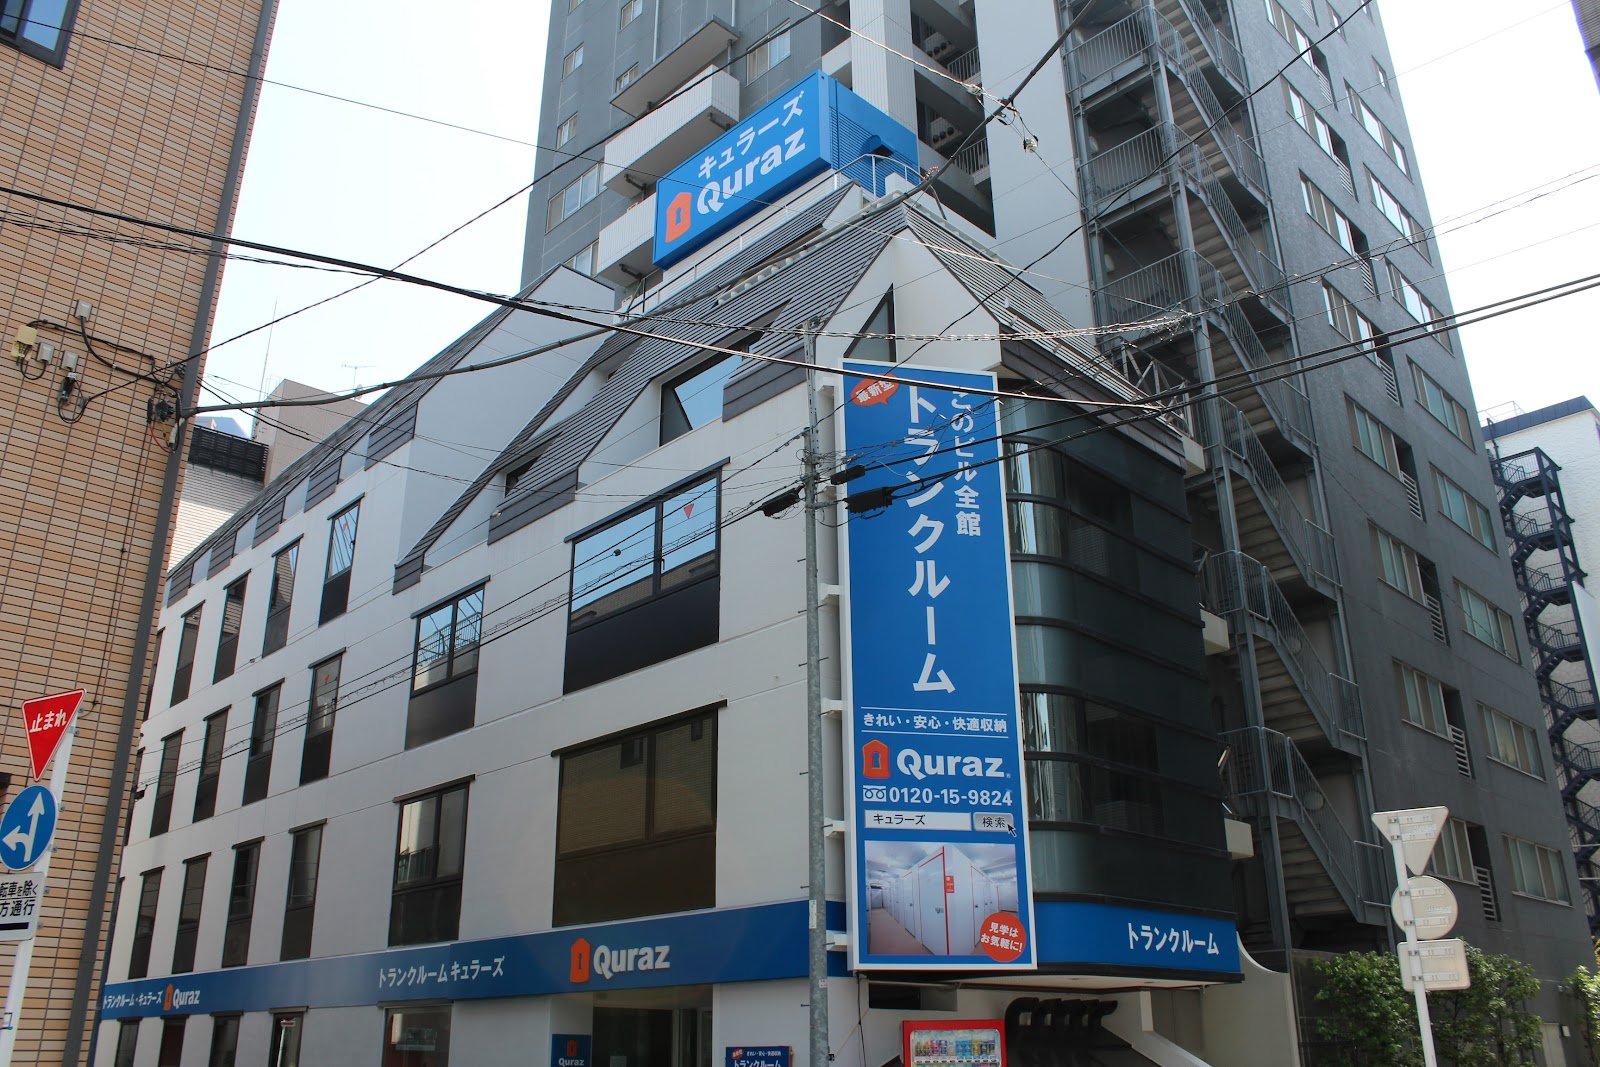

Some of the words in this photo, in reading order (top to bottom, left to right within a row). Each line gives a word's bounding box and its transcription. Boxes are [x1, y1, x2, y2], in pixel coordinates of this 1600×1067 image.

[698, 90, 805, 179] キュラーズ
[696, 127, 806, 215] Quraz
[856, 380, 895, 403] 最新型
[951, 391, 981, 537] このビル全館
[904, 385, 956, 694] トランクルーム
[29, 709, 67, 733] 止まれ
[863, 713, 1007, 733] きれい・安心・快適収納
[896, 748, 1005, 781] Quraz
[889, 787, 1013, 806] 0120-15-9824
[873, 813, 926, 825] キュラーズ
[982, 816, 1006, 828] 検索
[989, 921, 1019, 938] 見学は
[1127, 922, 1220, 955] トランクルーム
[593, 944, 671, 980] Quraz
[173, 988, 201, 1010] Quraz
[558, 1057, 585, 1067] Quraz
